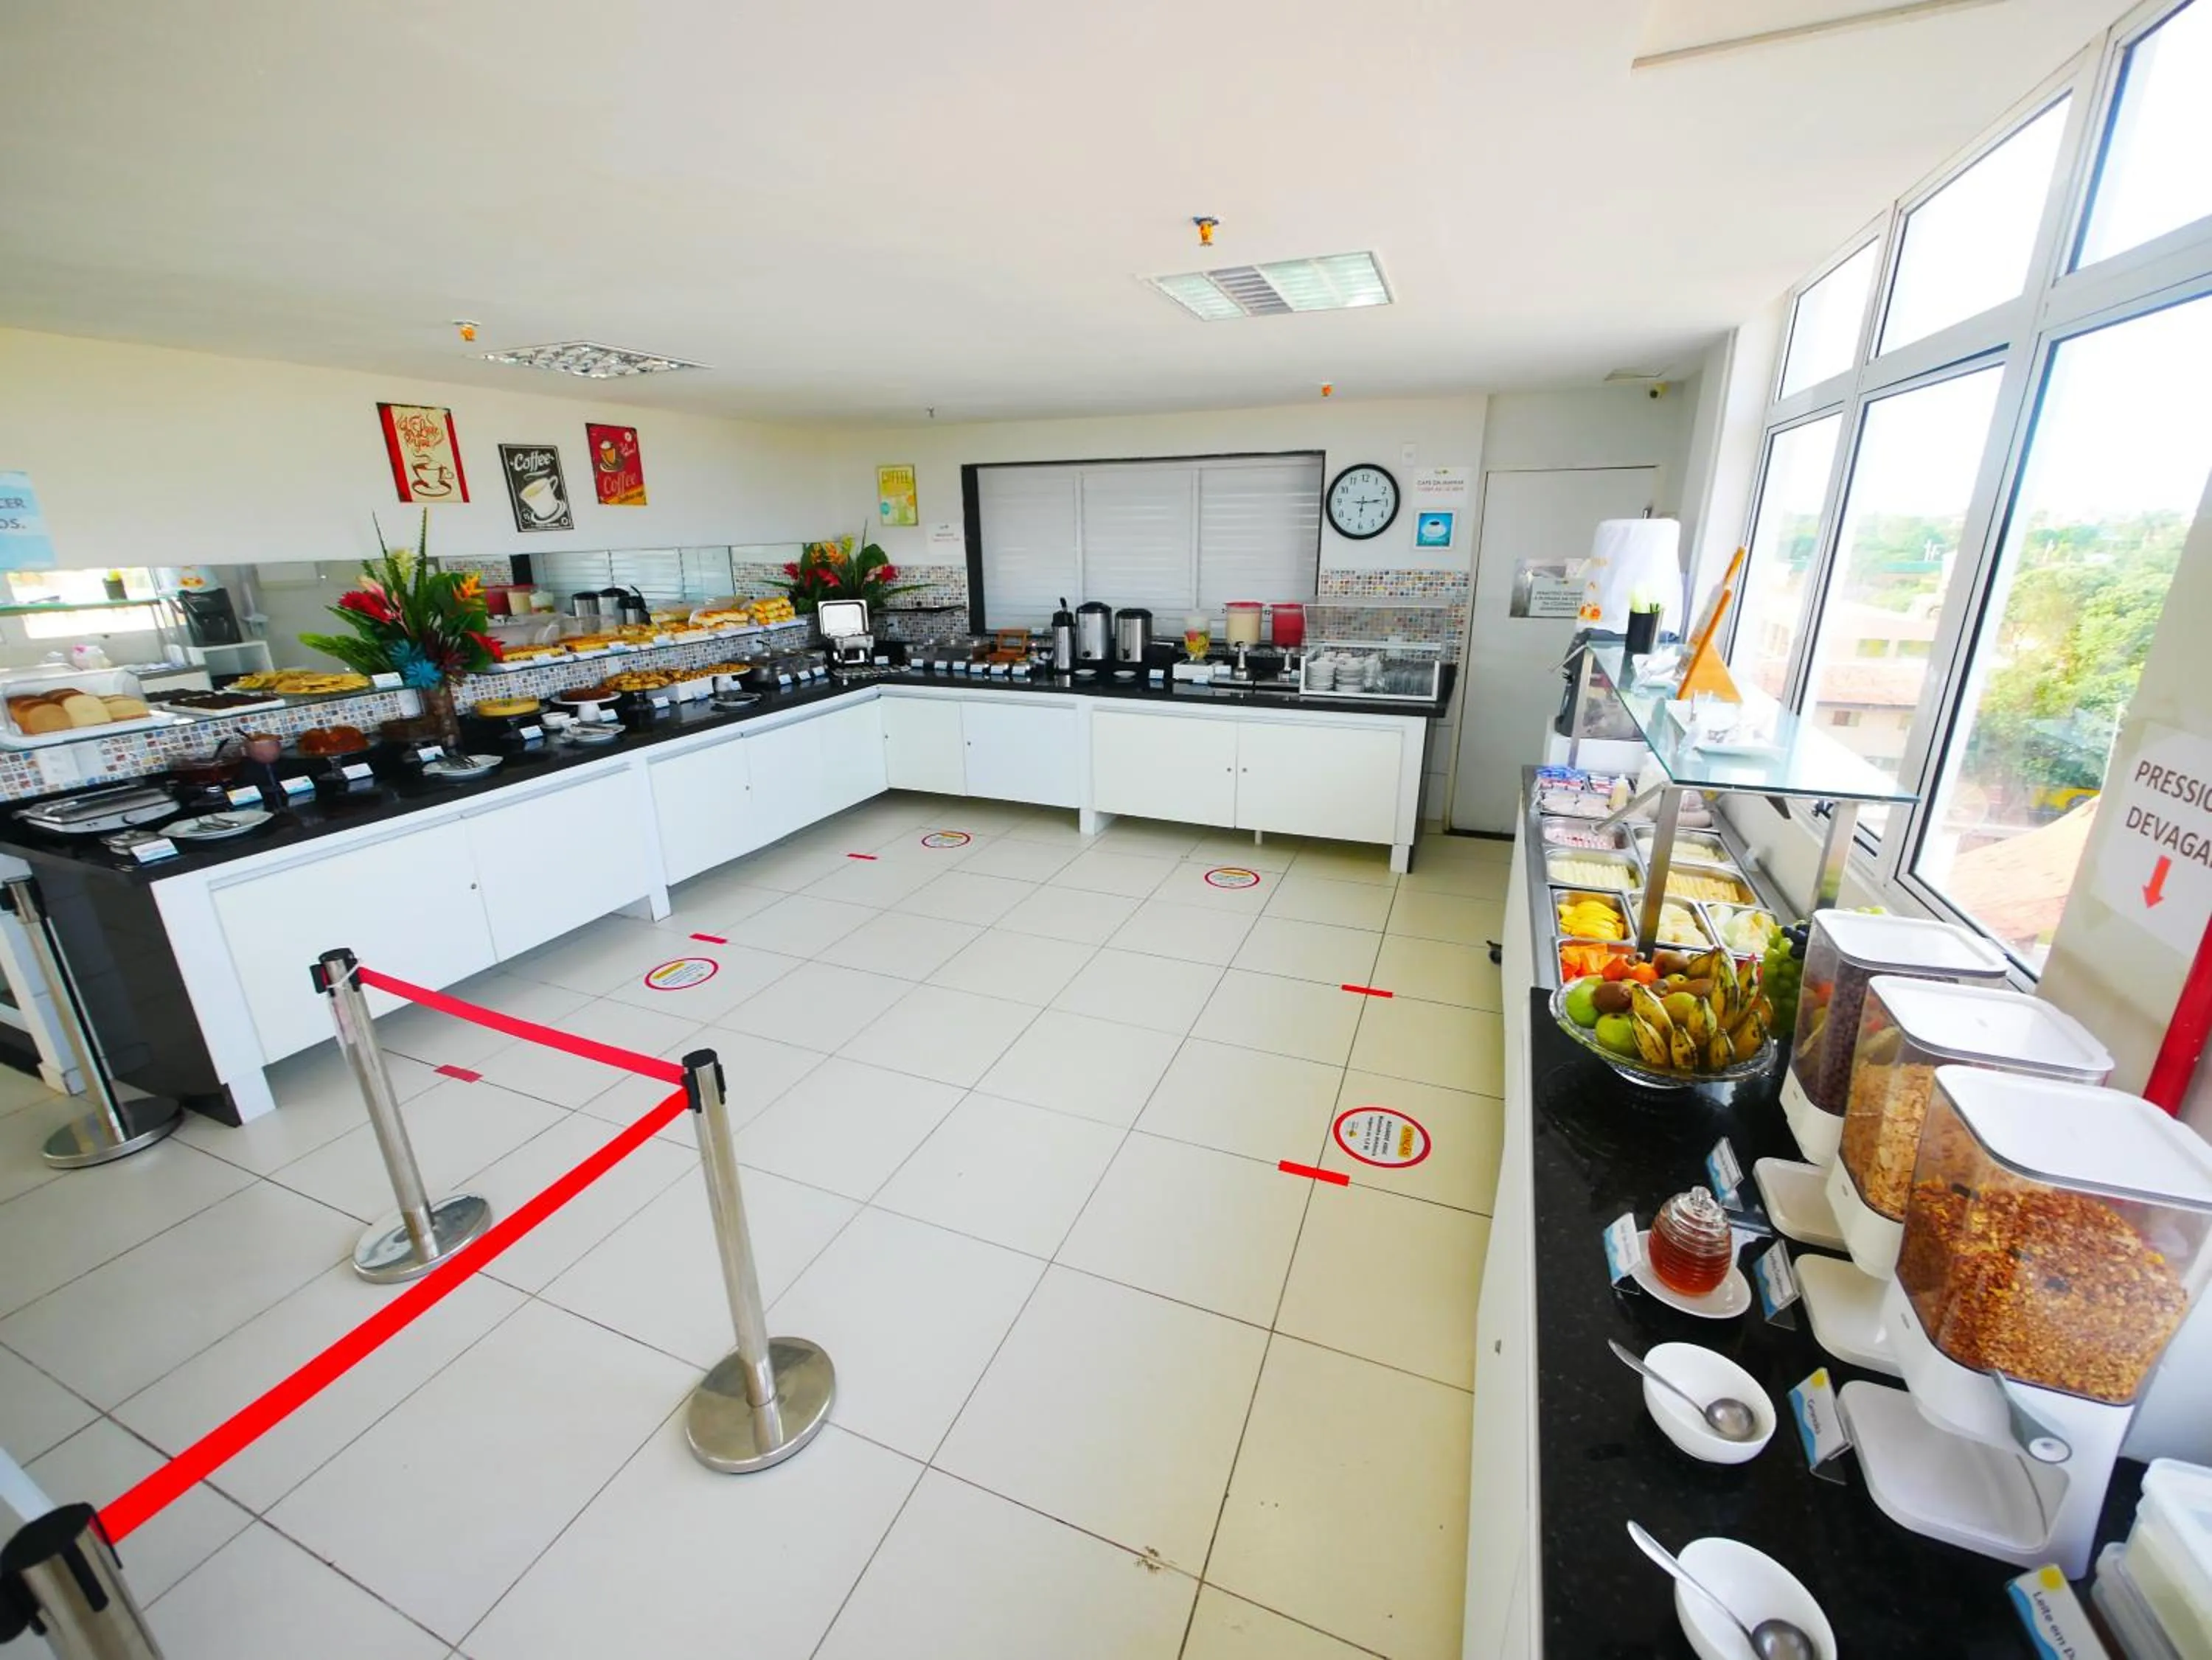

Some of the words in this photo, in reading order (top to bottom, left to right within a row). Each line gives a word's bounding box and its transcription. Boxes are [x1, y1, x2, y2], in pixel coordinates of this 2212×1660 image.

[514, 450, 552, 472] Coffee
[604, 472, 637, 498] Coffee
[1361, 474, 1370, 483] 12
[1381, 486, 1387, 495] 2
[1357, 521, 1363, 530] 6
[2126, 806, 2212, 868] DEVAGA
[2033, 1591, 2053, 1622] Leite
[2050, 1625, 2066, 1645] em
[2063, 1647, 2076, 1660] P
